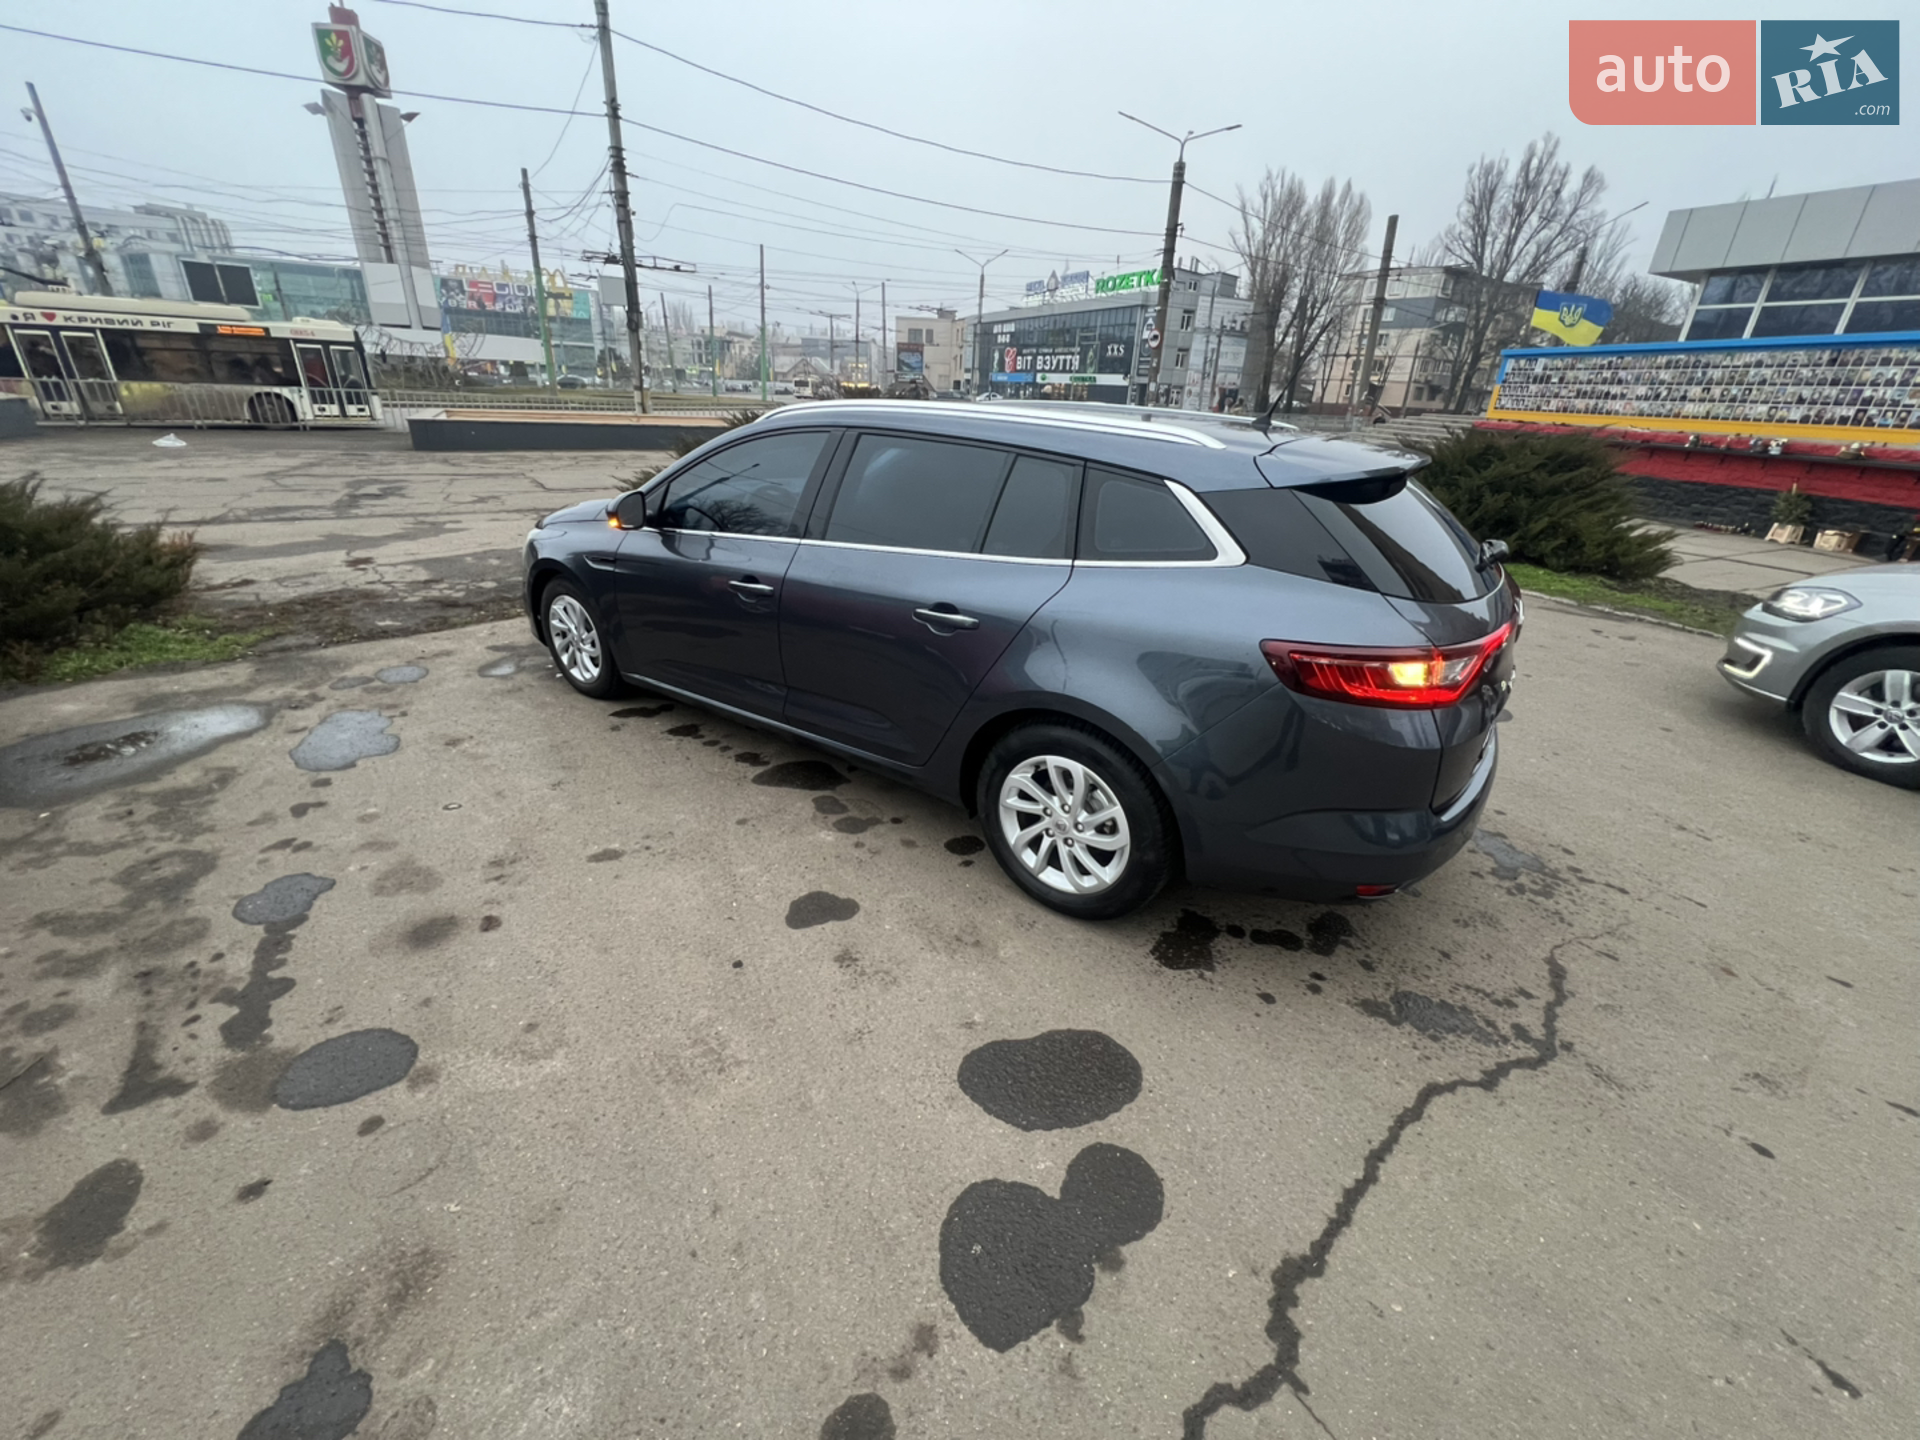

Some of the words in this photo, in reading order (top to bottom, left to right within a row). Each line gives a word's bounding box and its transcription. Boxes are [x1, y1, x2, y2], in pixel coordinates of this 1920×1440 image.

[22, 312, 36, 322] Я
[62, 314, 144, 328] КРИВИЙ
[1106, 343, 1125, 357] XXS
[1036, 354, 1080, 371] ВЗУТТЯ
